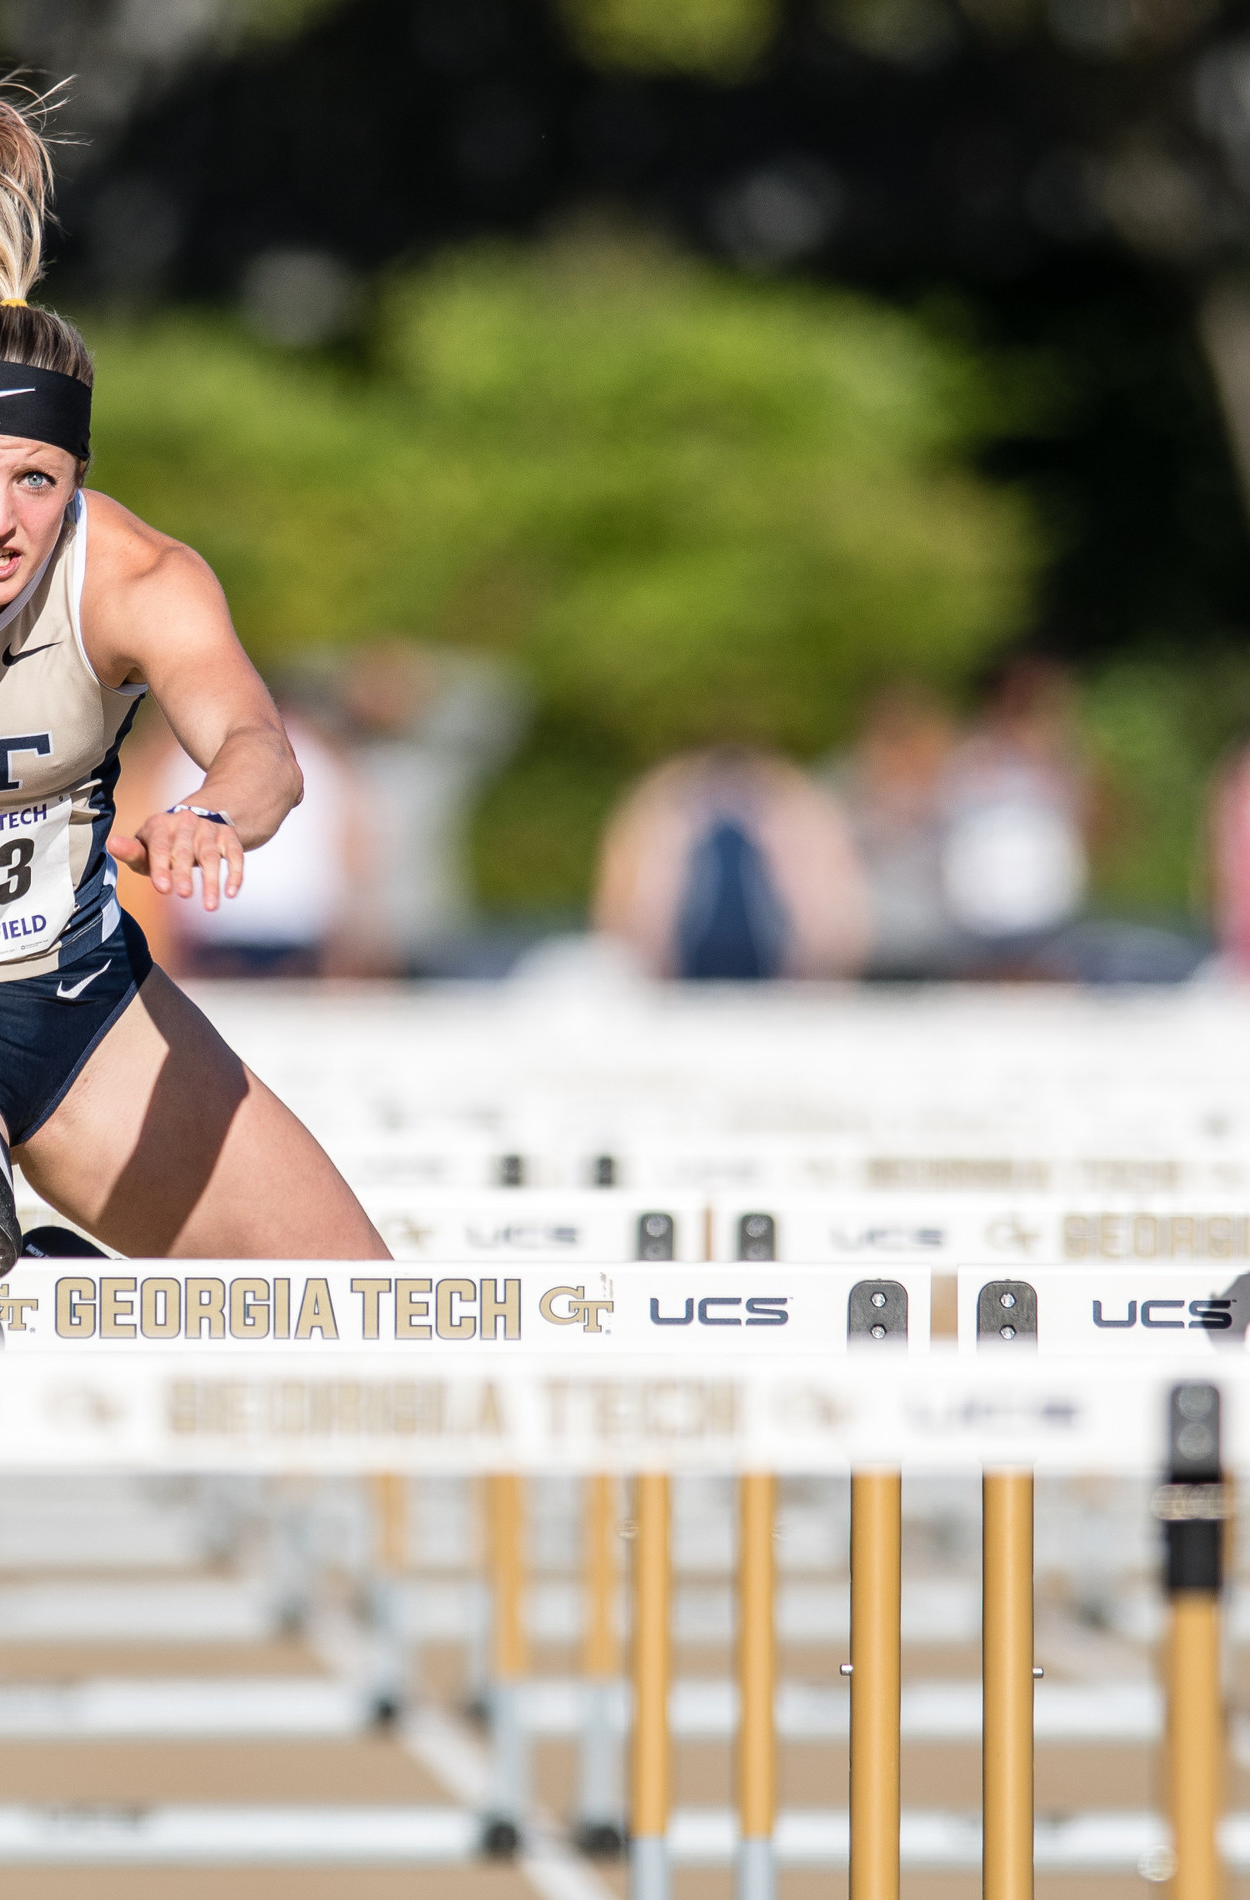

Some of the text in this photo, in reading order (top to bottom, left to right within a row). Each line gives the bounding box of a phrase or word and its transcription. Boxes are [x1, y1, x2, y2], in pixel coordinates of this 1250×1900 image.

[54, 1276, 340, 1340] GEORGIA
[350, 1278, 522, 1341] TECH
[650, 1297, 789, 1326] UCS
[1093, 1300, 1233, 1329] UCS
